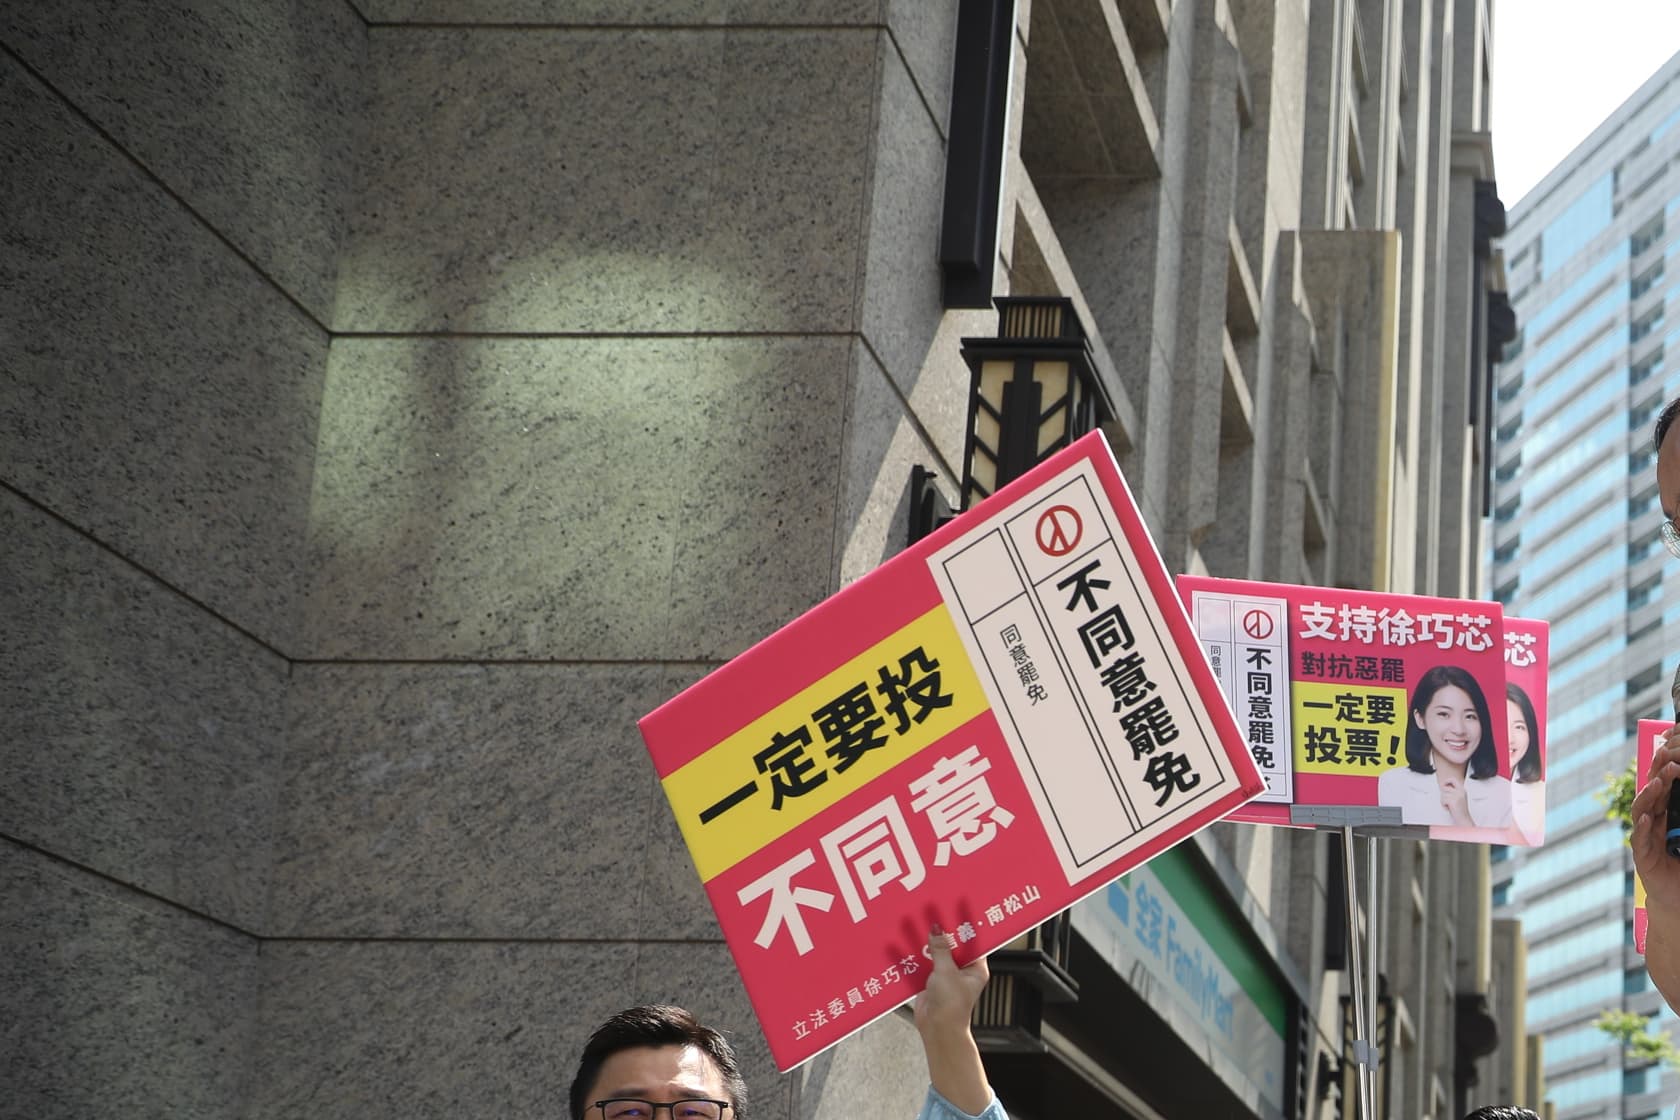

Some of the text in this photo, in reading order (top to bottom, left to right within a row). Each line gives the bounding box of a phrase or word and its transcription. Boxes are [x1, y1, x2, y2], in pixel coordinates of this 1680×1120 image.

[1000, 623, 1048, 705] 同意罷免
[1210, 645, 1222, 683] 同意罷
[1299, 601, 1493, 652] 支持徐巧芯
[1301, 651, 1405, 683] 對抗惡罷
[1504, 631, 1536, 667] 芯
[1056, 560, 1200, 807] 不同意罷免
[1246, 648, 1275, 769] 不同意罷免
[1303, 693, 1395, 725] 一定要
[699, 646, 954, 825] 一定要投
[738, 744, 1015, 957] 不同意
[792, 955, 920, 1041] 立法委員徐巧芯
